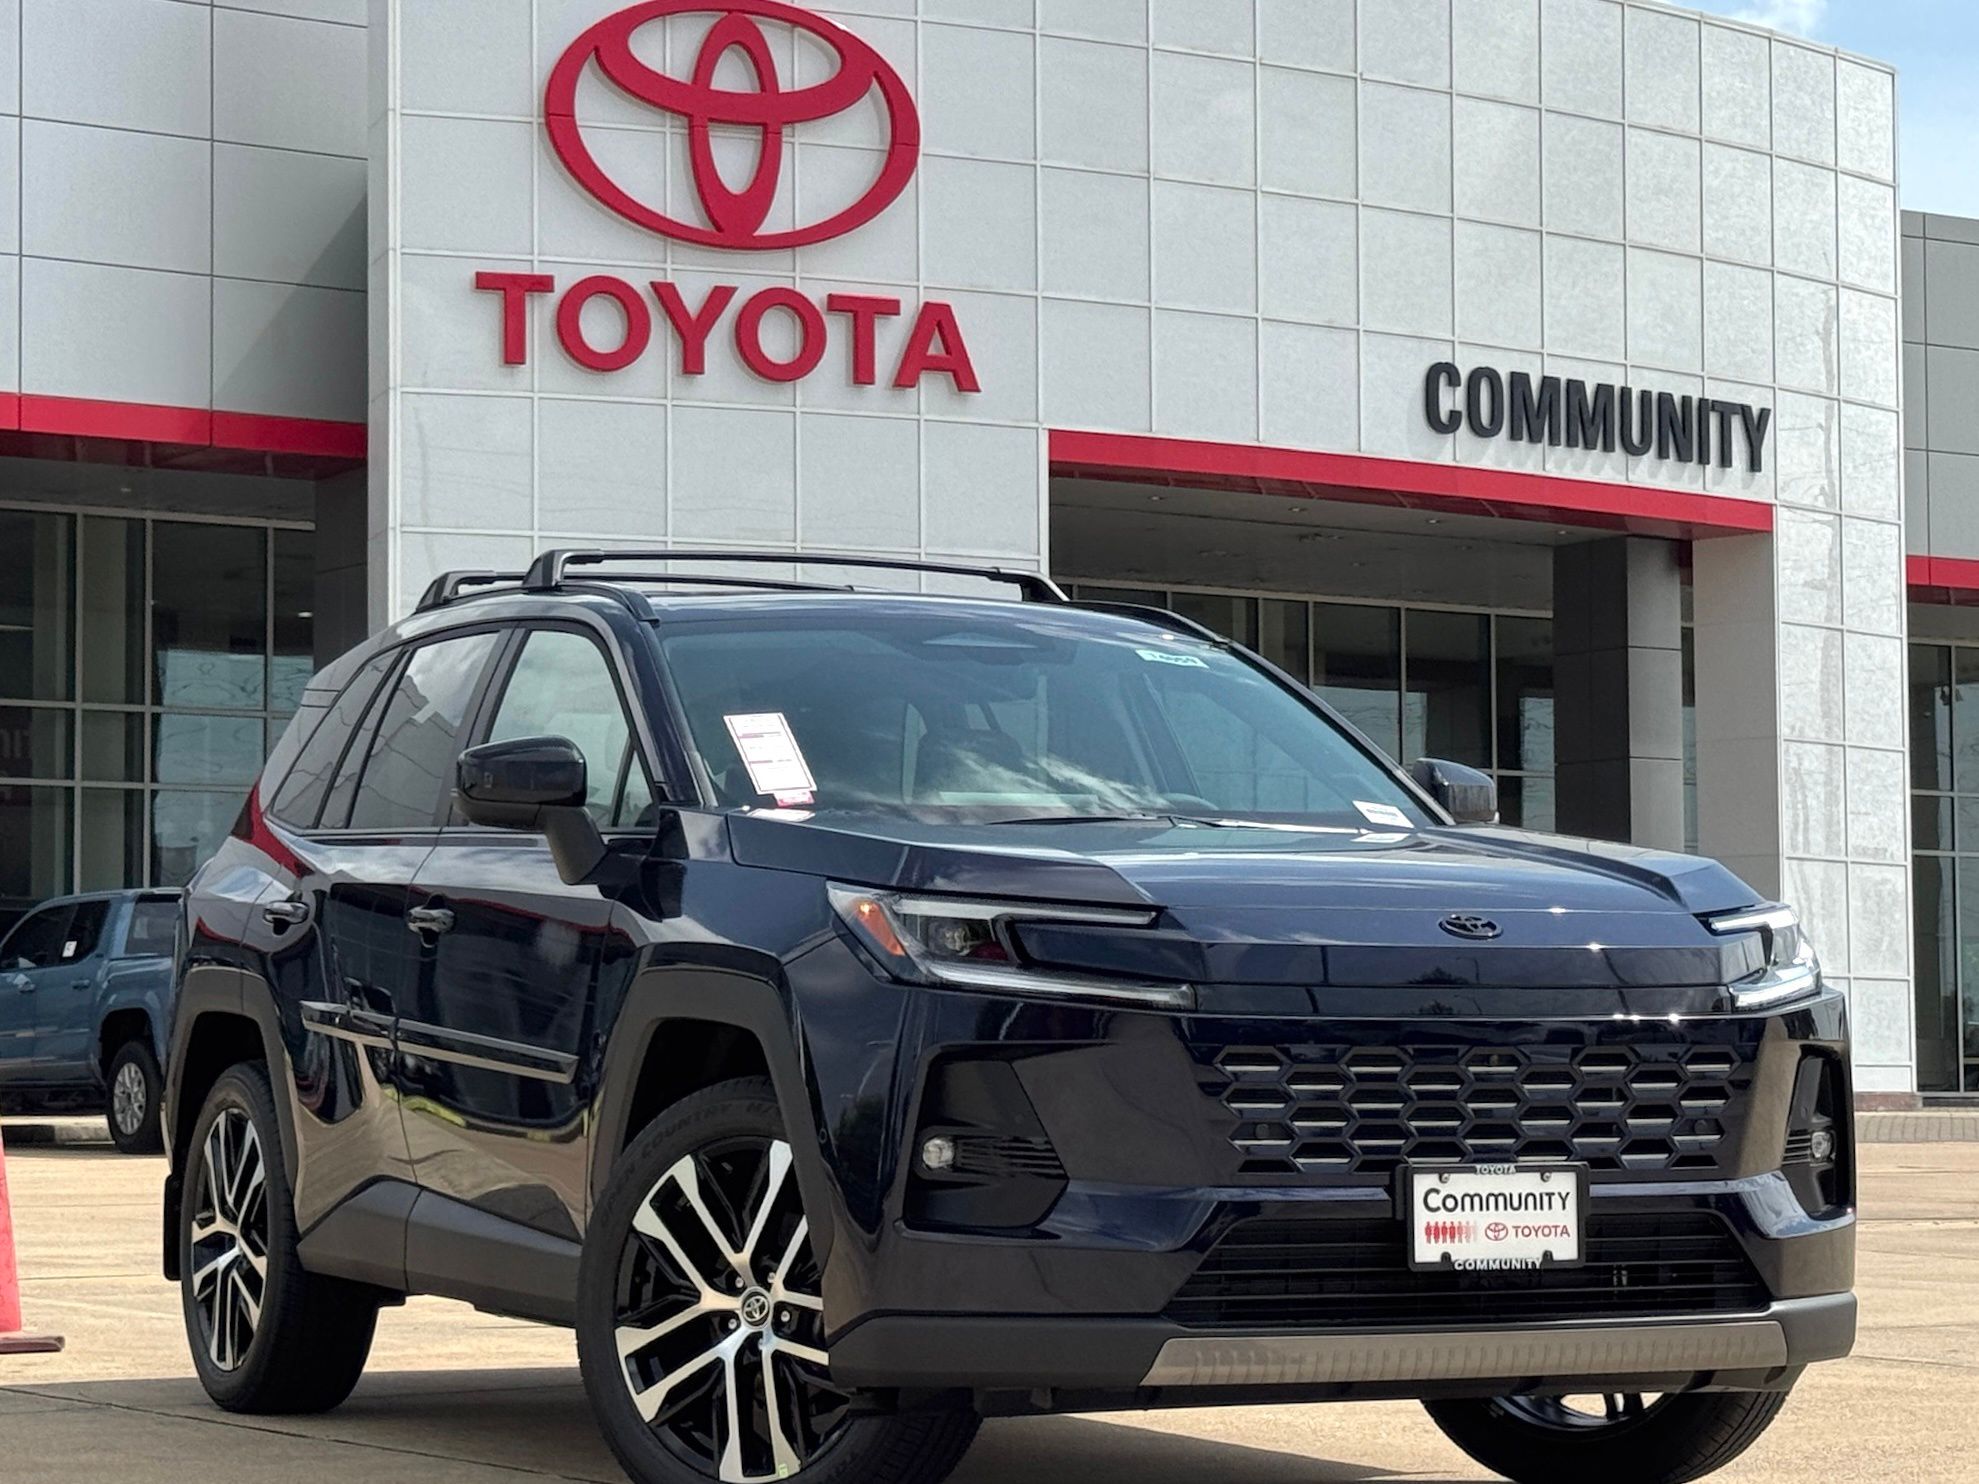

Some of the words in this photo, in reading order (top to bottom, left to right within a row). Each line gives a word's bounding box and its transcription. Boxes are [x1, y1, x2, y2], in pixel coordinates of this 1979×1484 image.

[475, 271, 981, 393] TOYOTA
[1425, 361, 1771, 472] COMMUNITY
[1474, 1164, 1517, 1175] TOYOTA
[1512, 1225, 1571, 1239] TOYOTA
[1454, 1258, 1542, 1271] COMMUNITY
